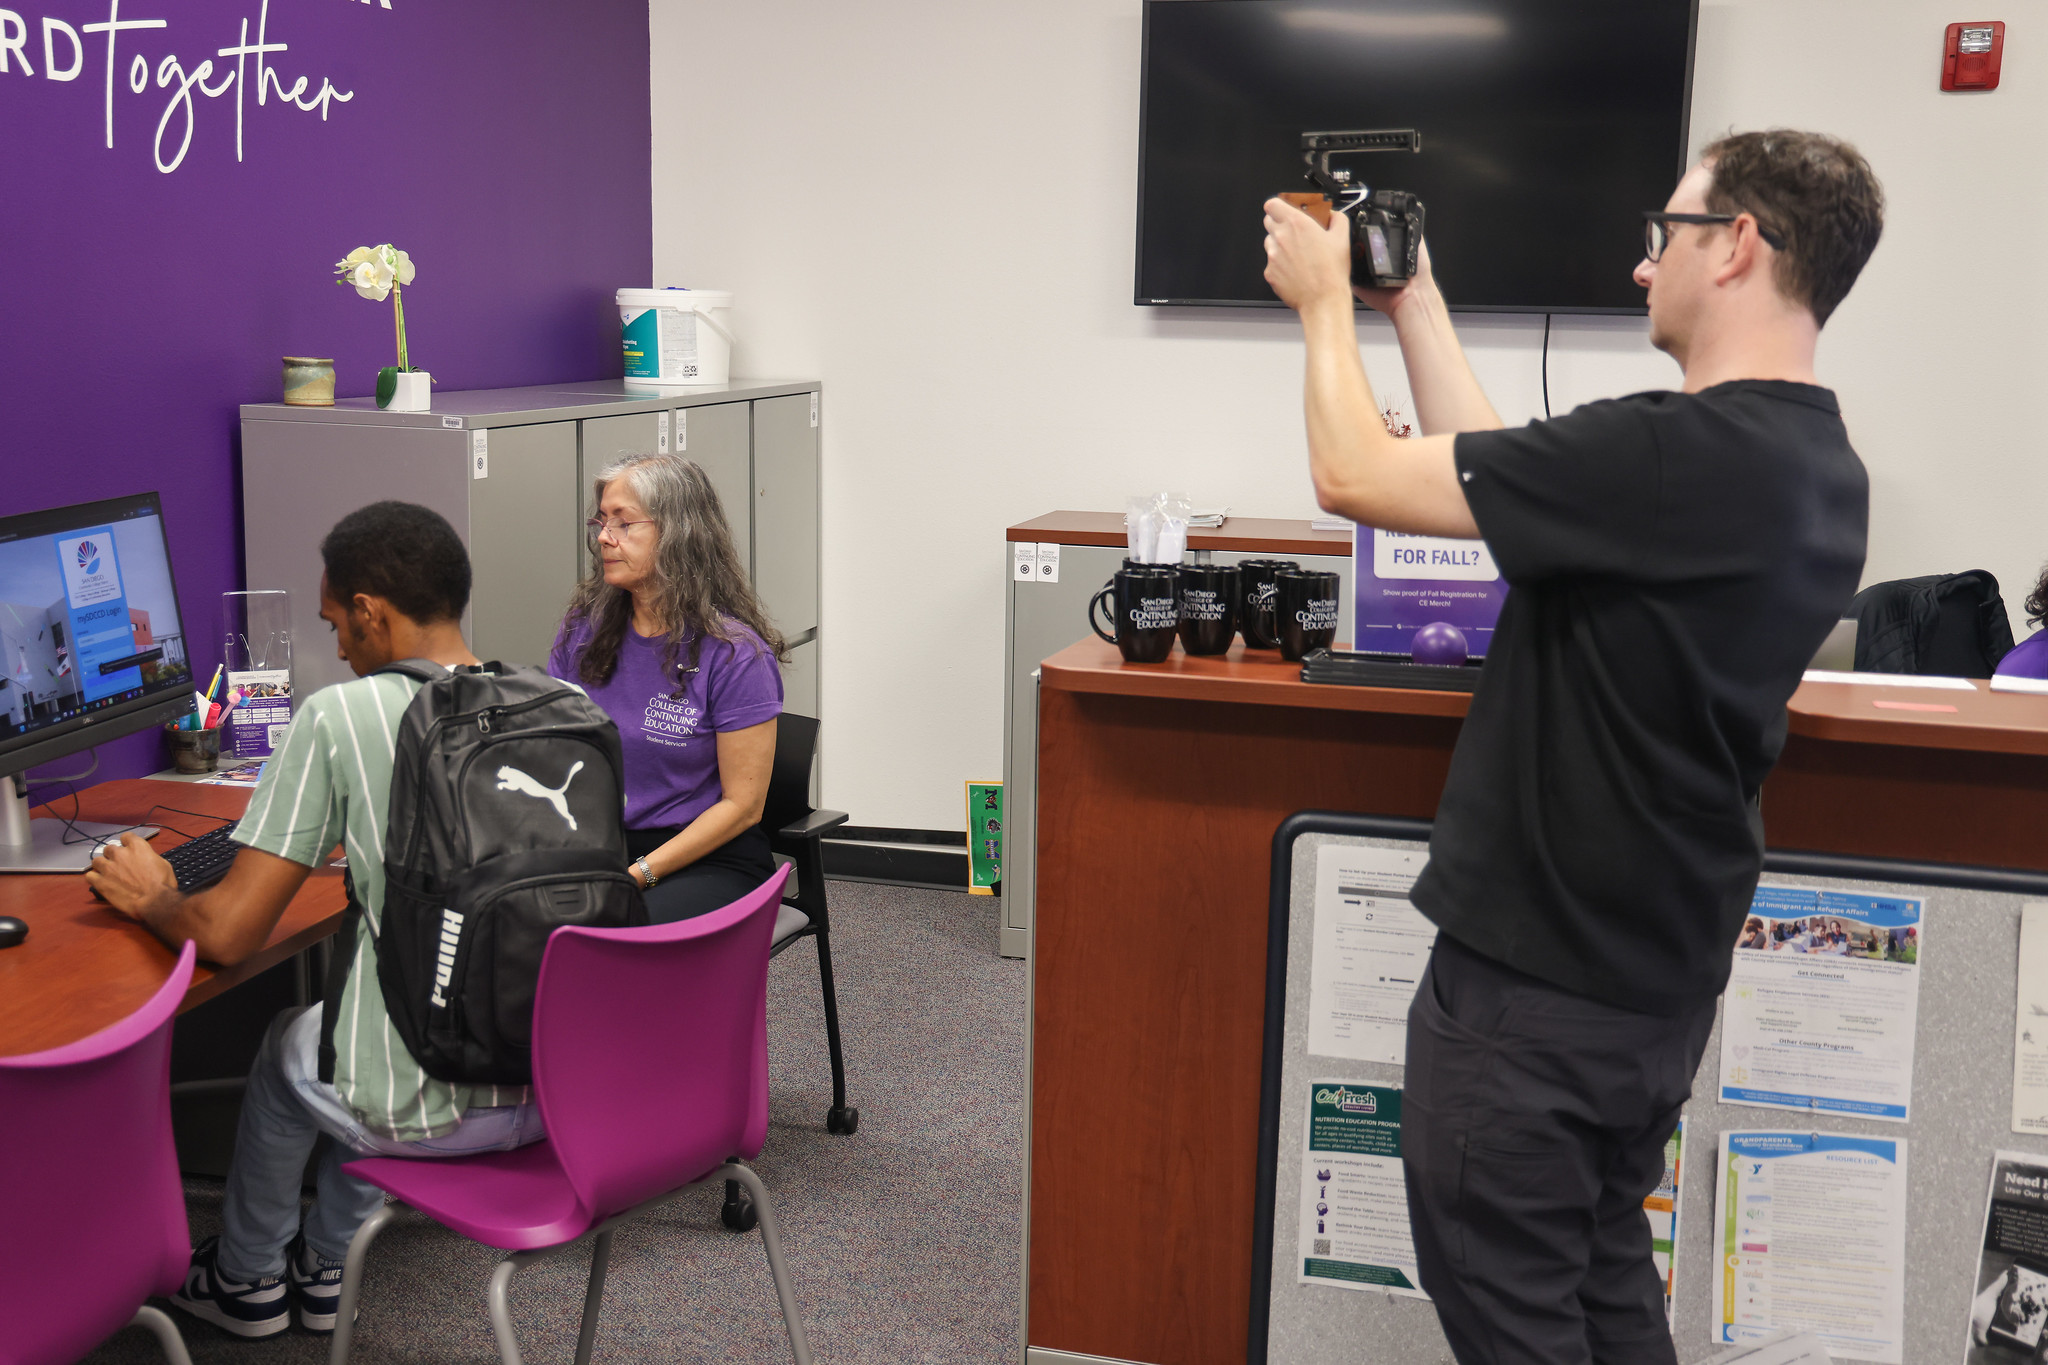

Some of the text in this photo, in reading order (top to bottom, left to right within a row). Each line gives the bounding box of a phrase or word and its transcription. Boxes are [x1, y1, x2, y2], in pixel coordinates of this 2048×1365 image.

[1393, 549, 1480, 566] FOR FALL?
[1440, 591, 1477, 599] Registration
[1179, 600, 1225, 613] ONTINUING
[1296, 611, 1338, 623] CONTINUIN
[1302, 621, 1336, 631] EDUCATIO
[657, 692, 669, 700] SAN
[649, 697, 697, 716] COLLEGE OF
[644, 707, 698, 727] CONTINUING
[644, 717, 693, 735] EDUCATION
[646, 734, 687, 747] Student Services
[1766, 902, 1801, 911] Immigrant
[1817, 906, 1844, 914] Refugee
[1846, 908, 1869, 916] Affairs
[431, 908, 464, 1008] PUMA
[1810, 971, 1845, 979] Connected
[1799, 1040, 1822, 1049] County
[1823, 1042, 1854, 1051] Programs
[1346, 1117, 1377, 1125] EDUCATION
[1378, 1120, 1401, 1128] PROGRA
[1826, 1155, 1878, 1165] RESOURCE LIST
[2005, 1172, 2040, 1188] Need
[2005, 1186, 2040, 1199] Use Our
[320, 1269, 342, 1280] NIKE
